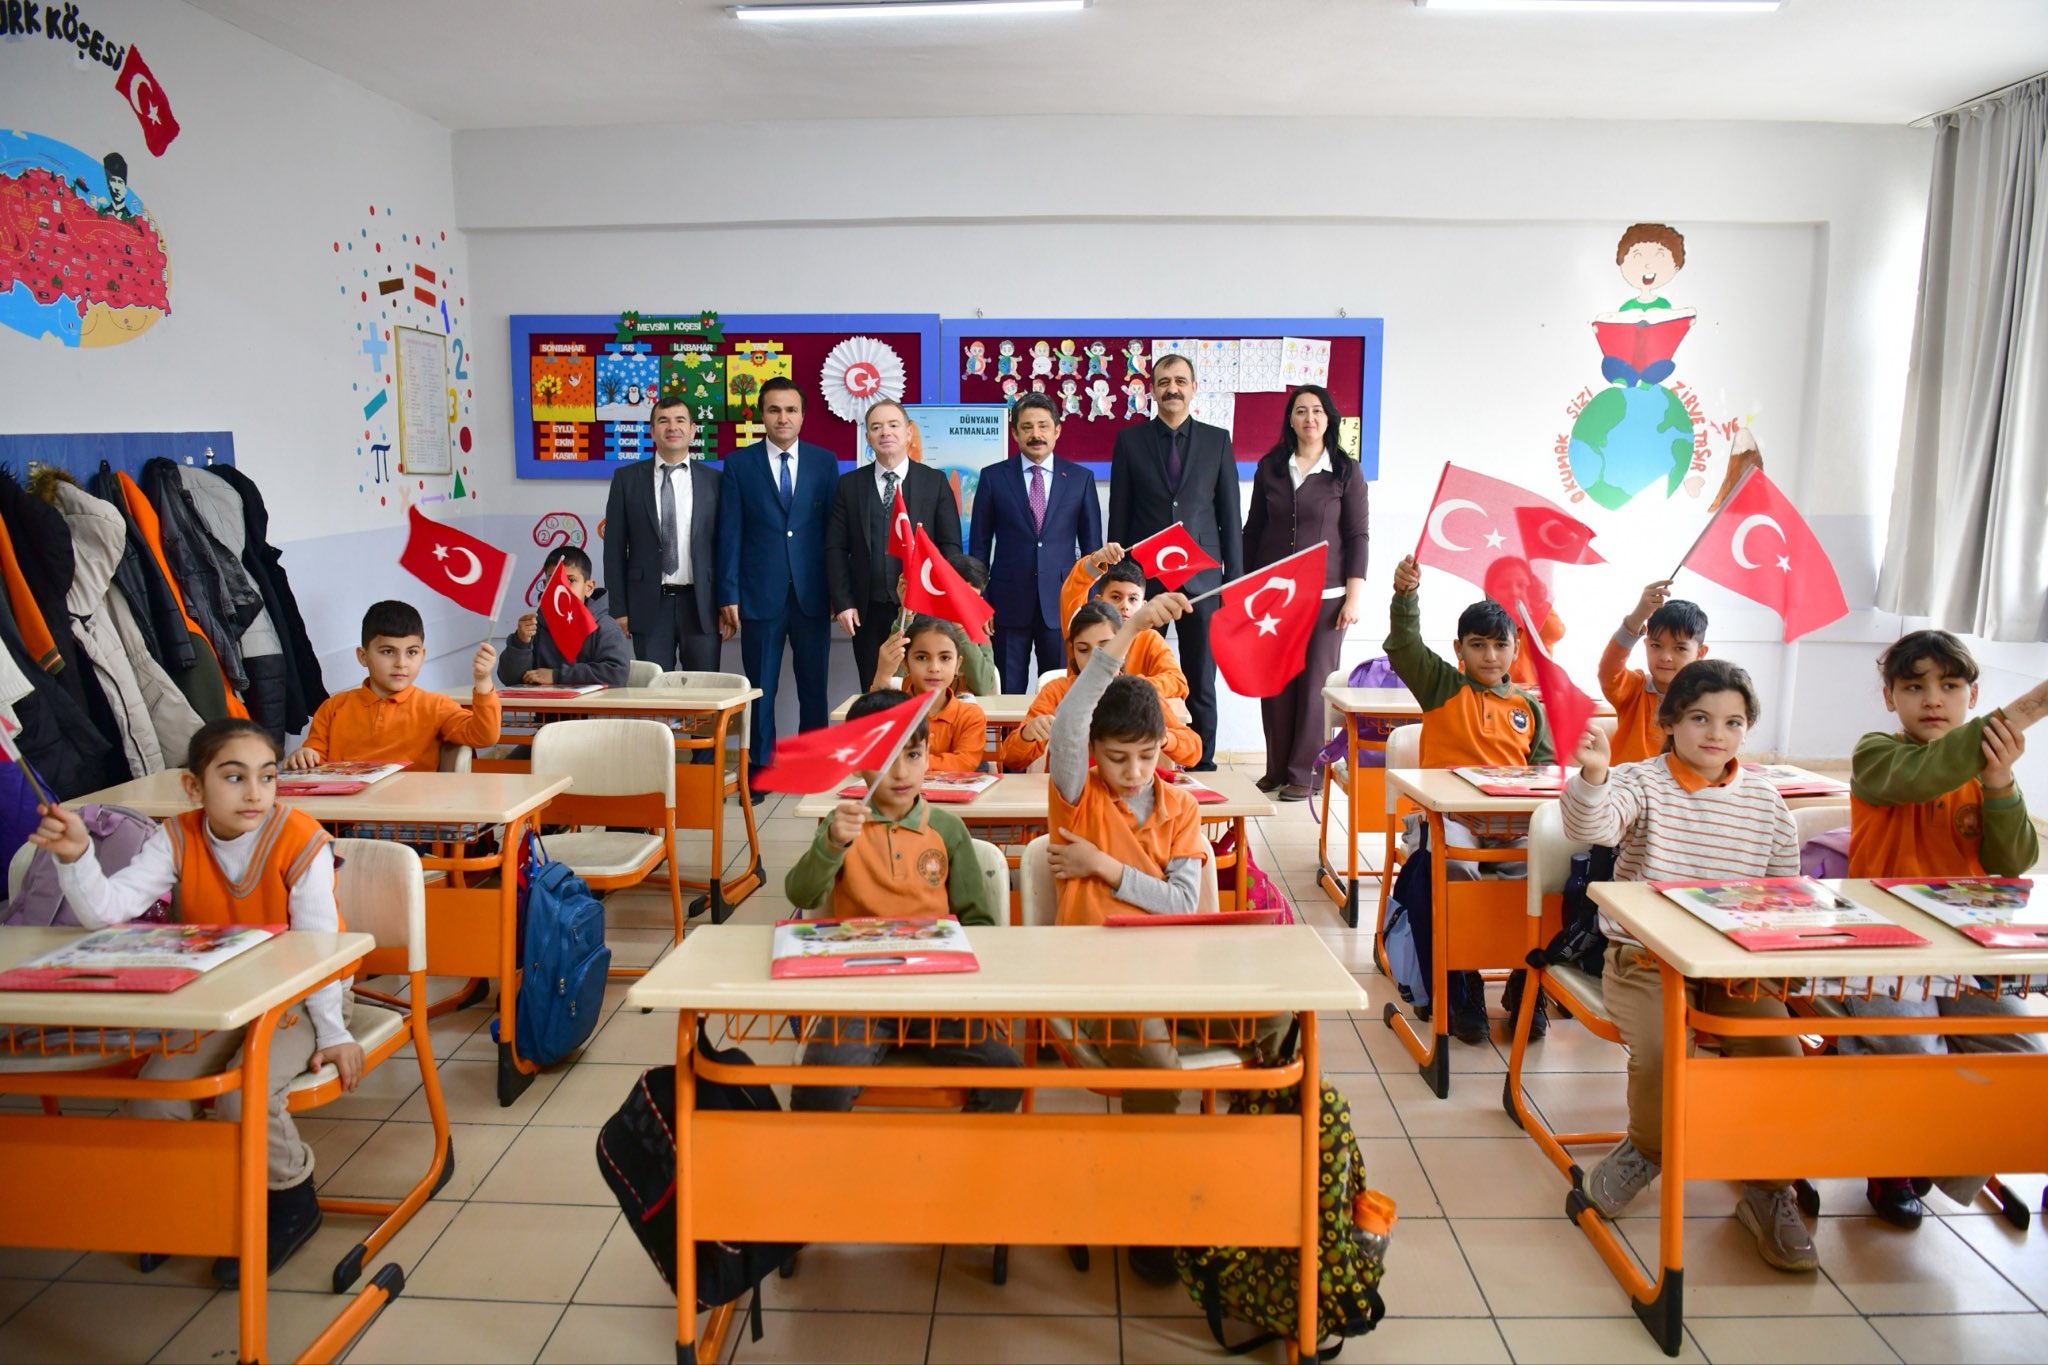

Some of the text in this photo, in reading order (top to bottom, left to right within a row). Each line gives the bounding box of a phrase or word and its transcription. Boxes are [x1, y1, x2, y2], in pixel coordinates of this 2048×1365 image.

[46, 1, 125, 71] KÖŞESİ
[637, 321, 701, 332] MEVSİM KÖŞESİ
[542, 344, 584, 352] SONBAHAR
[622, 344, 634, 352] KIŞ
[673, 342, 713, 352] İLKBAHAR
[452, 338, 468, 380] 2
[448, 387, 458, 423] 3
[1566, 386, 1593, 420] SİZİ
[1669, 381, 1706, 426] ZİRVE
[960, 414, 999, 424] DÜNYANIN
[553, 423, 577, 433] EYLÜL
[614, 424, 645, 432] ARALIK
[949, 427, 999, 435] KATMANLARI
[1353, 422, 1359, 430] 2
[554, 437, 574, 446] EKİM
[618, 438, 640, 446] OCAK
[1350, 436, 1358, 446] 3
[553, 452, 577, 460] KASIM
[617, 451, 641, 460] ŞUBAT
[1554, 433, 1585, 504] OKUMAK
